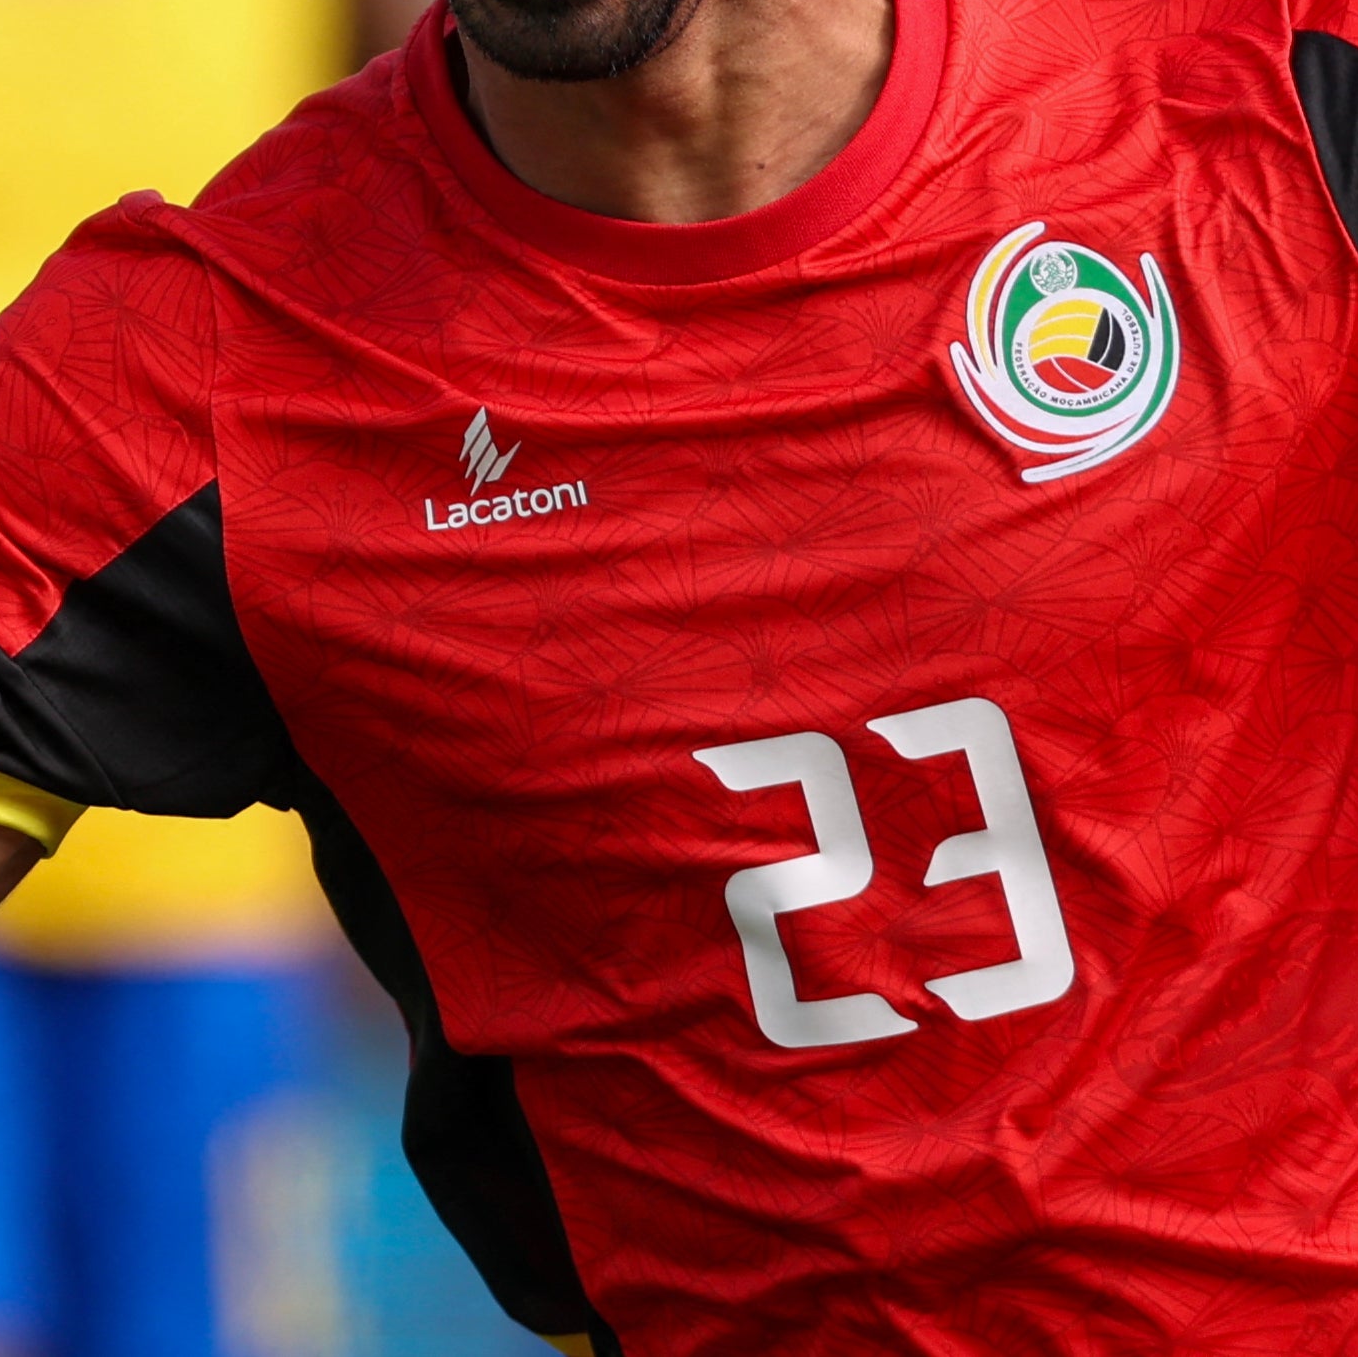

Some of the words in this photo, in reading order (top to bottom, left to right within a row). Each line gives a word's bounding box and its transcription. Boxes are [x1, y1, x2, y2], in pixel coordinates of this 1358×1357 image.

[1122, 309, 1141, 356] FUTEBOL
[1015, 342, 1047, 398] FEDERAÇÃO
[1127, 361, 1137, 373] DE
[1051, 377, 1128, 406] MOÇAMBICANA
[424, 480, 588, 530] Lacatoni
[691, 697, 1075, 1048] 23
